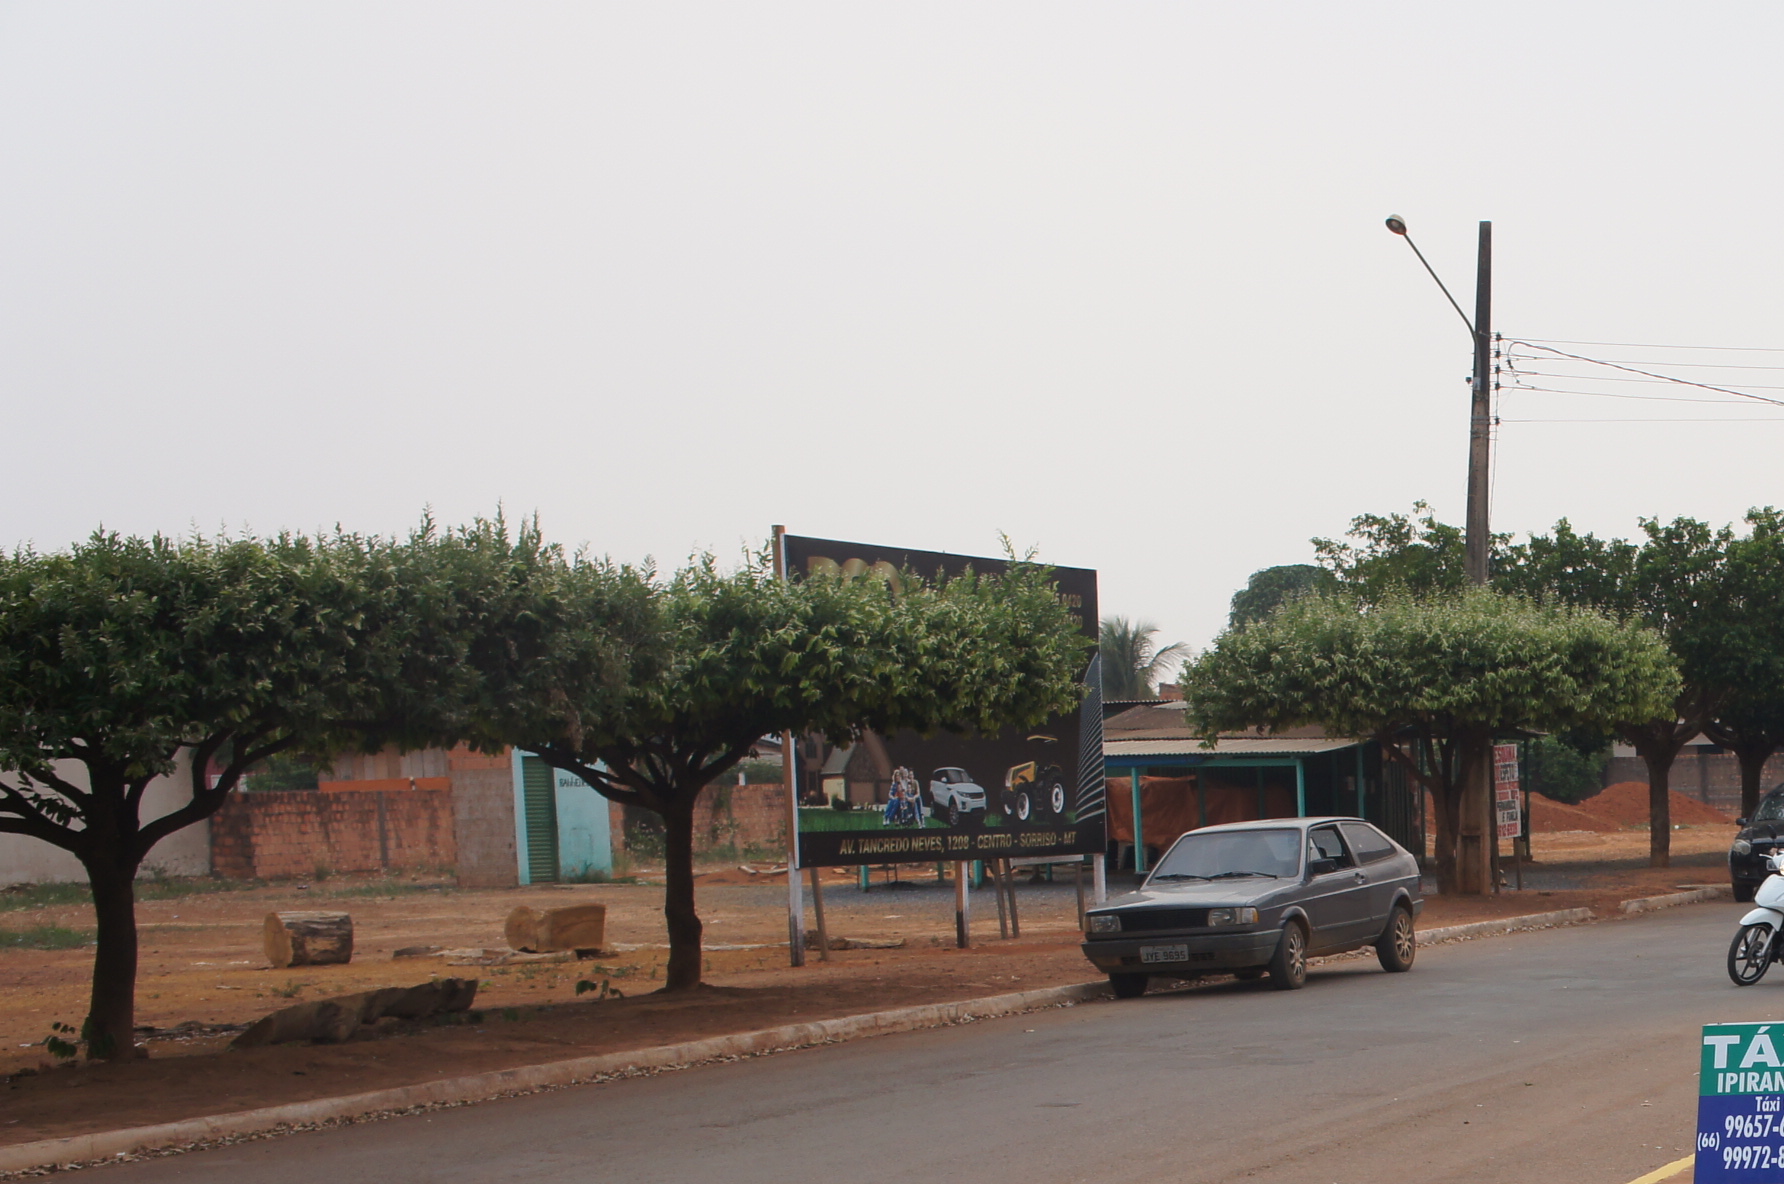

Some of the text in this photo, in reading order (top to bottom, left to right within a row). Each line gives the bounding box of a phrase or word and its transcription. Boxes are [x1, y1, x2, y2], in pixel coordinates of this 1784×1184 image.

[839, 838, 855, 854] AV.
[859, 837, 909, 854] TANCREDO
[911, 836, 945, 853] NEVES,
[947, 835, 969, 850] 1208
[977, 833, 1012, 849] CENTRO
[1020, 832, 1057, 848] SORRISO
[1064, 831, 1077, 844] MT
[1143, 950, 1186, 962] JYE 9695
[1755, 1095, 1781, 1112] Táxi
[1697, 1132, 1720, 1151] (66)
